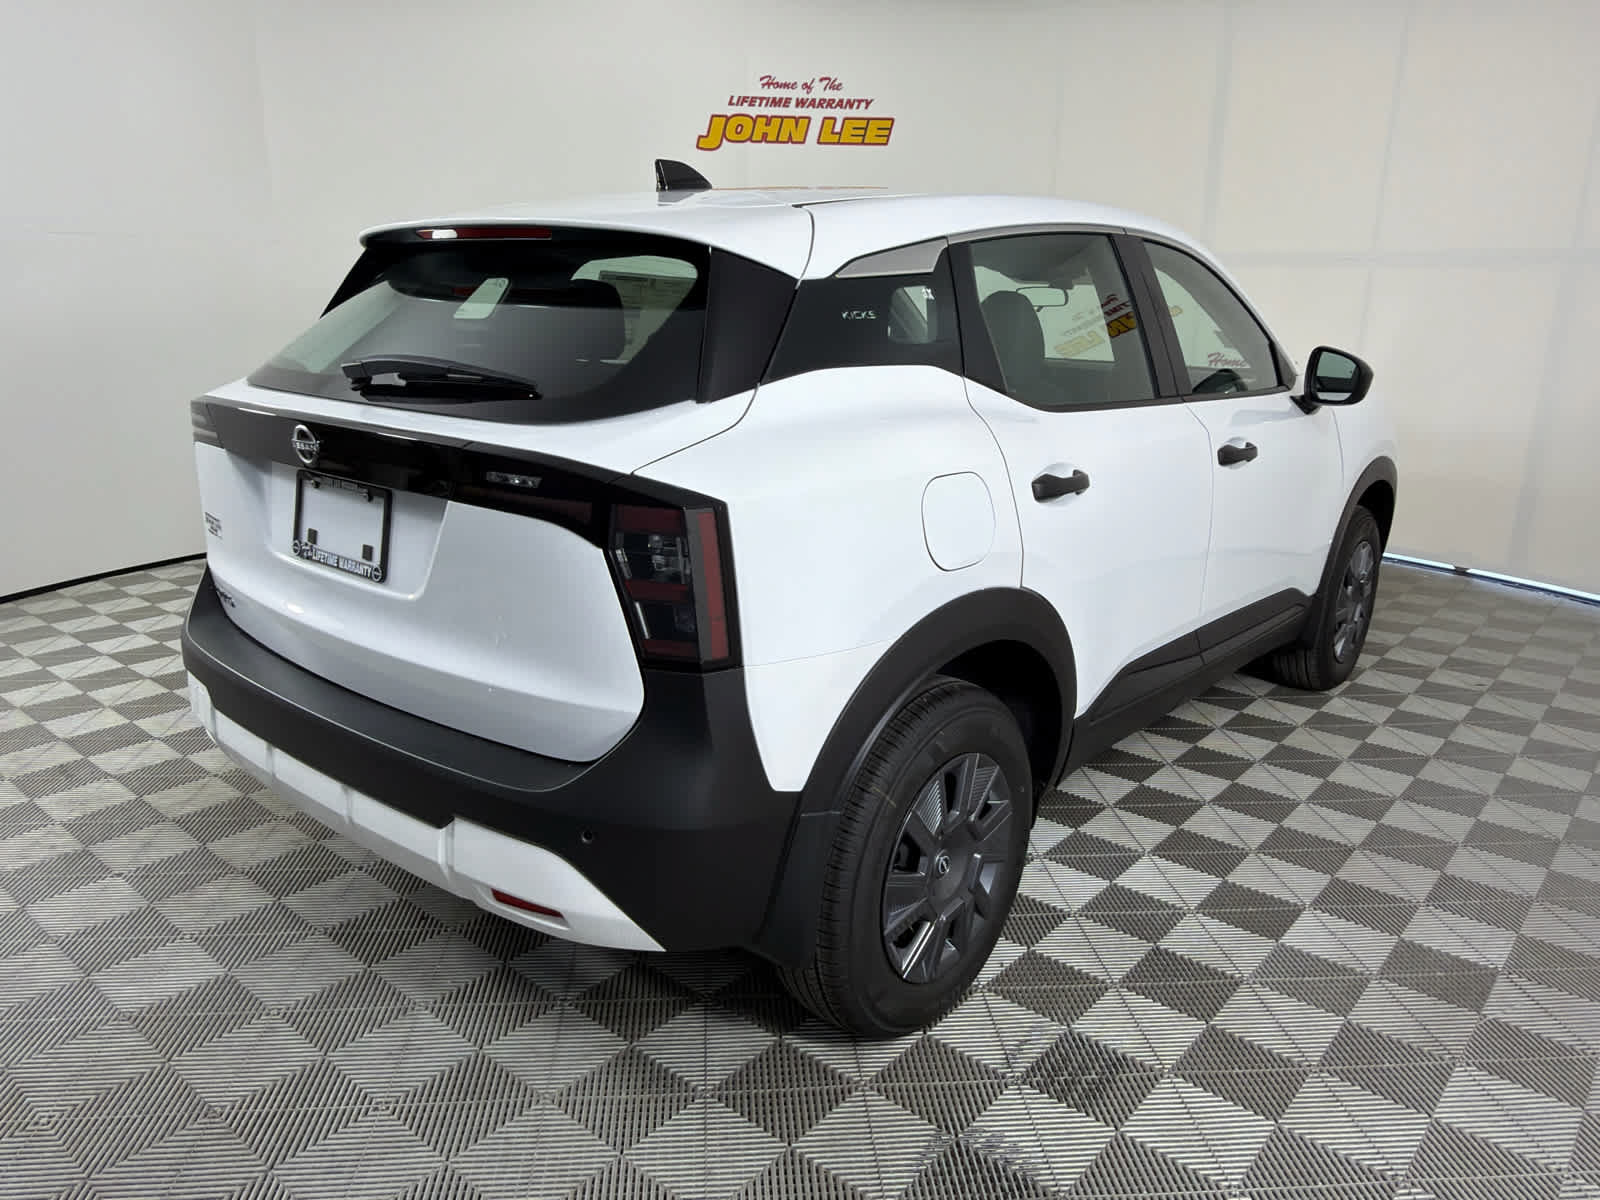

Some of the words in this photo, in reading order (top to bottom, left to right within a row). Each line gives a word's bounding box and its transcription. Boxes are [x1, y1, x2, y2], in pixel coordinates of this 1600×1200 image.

[760, 75, 798, 90] Home
[801, 78, 816, 95] of
[819, 76, 843, 92] The
[728, 95, 792, 108] LIFETIME
[795, 97, 874, 110] WARRANTY
[696, 113, 811, 151] JOHN
[817, 116, 895, 146] LEE
[312, 548, 338, 567] LIFETIME
[339, 558, 372, 578] WARRANTY
